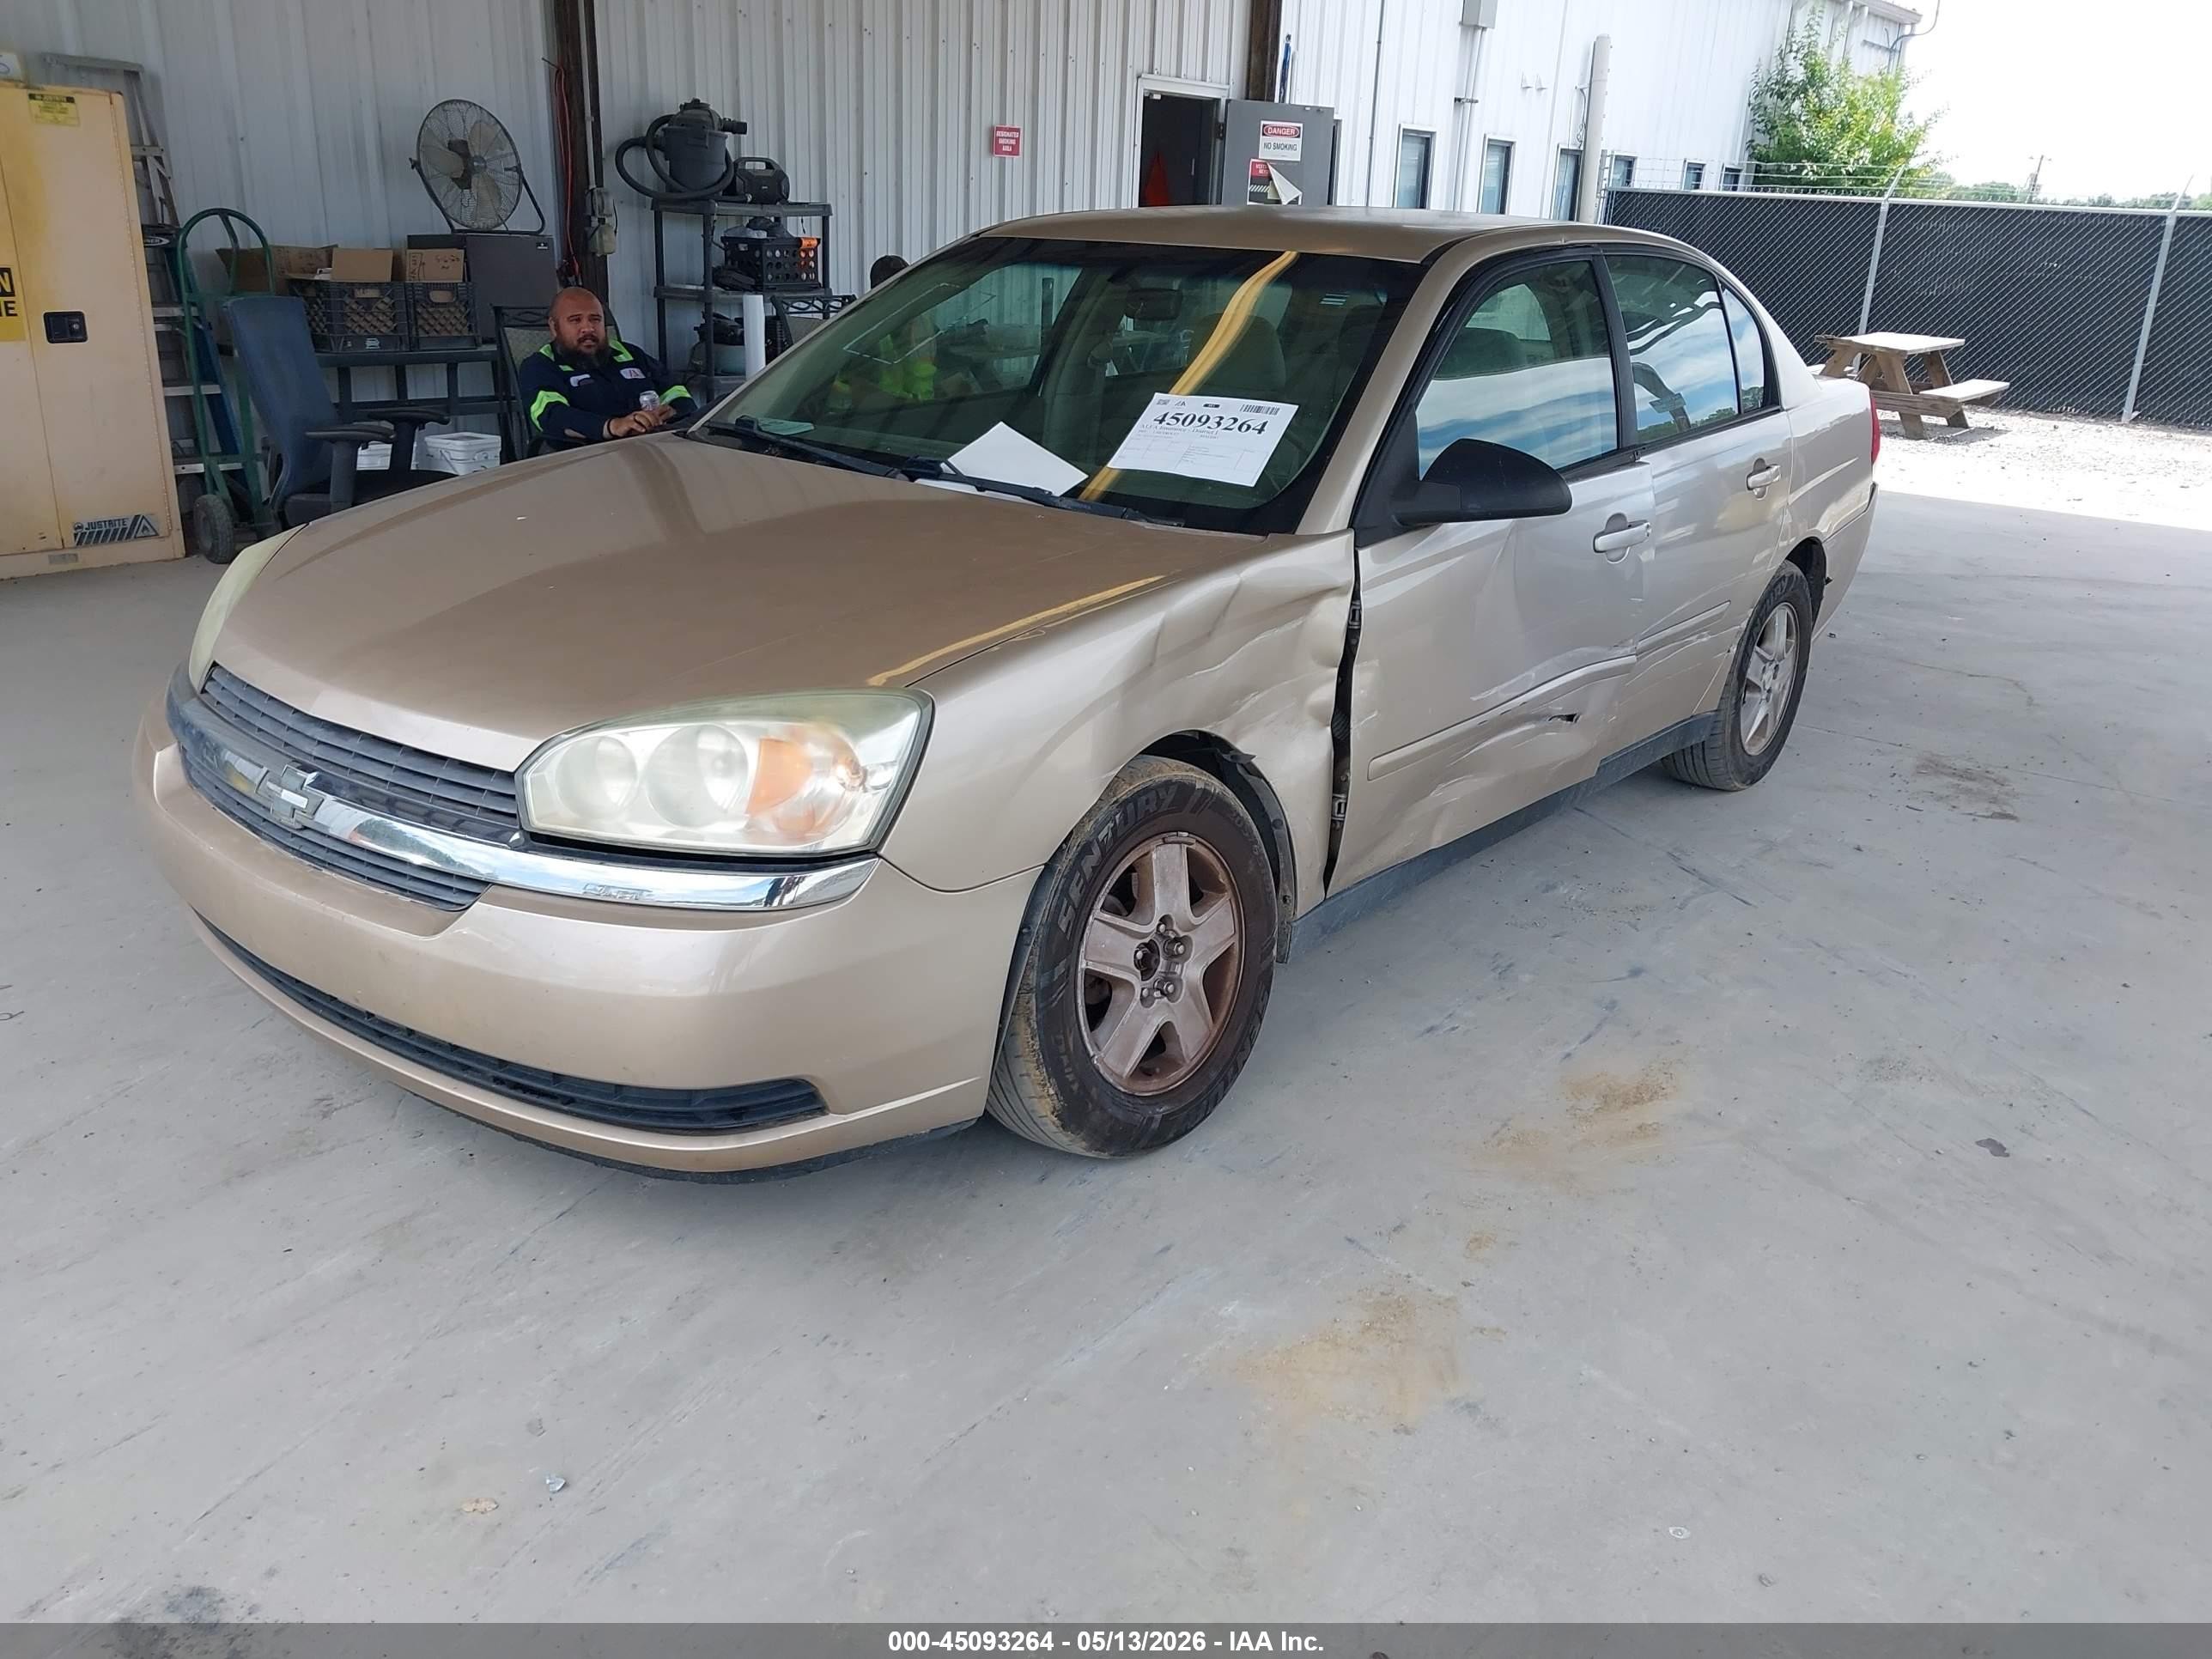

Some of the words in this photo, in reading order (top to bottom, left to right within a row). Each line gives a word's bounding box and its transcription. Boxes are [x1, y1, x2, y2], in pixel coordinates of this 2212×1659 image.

[1267, 126, 1296, 136] DANGER
[1263, 142, 1272, 150] NO
[1273, 143, 1297, 152] SMOKING
[1153, 411, 1268, 434] 45093264
[85, 519, 128, 531] JUSTRITE
[1056, 783, 1179, 938] SENTURY
